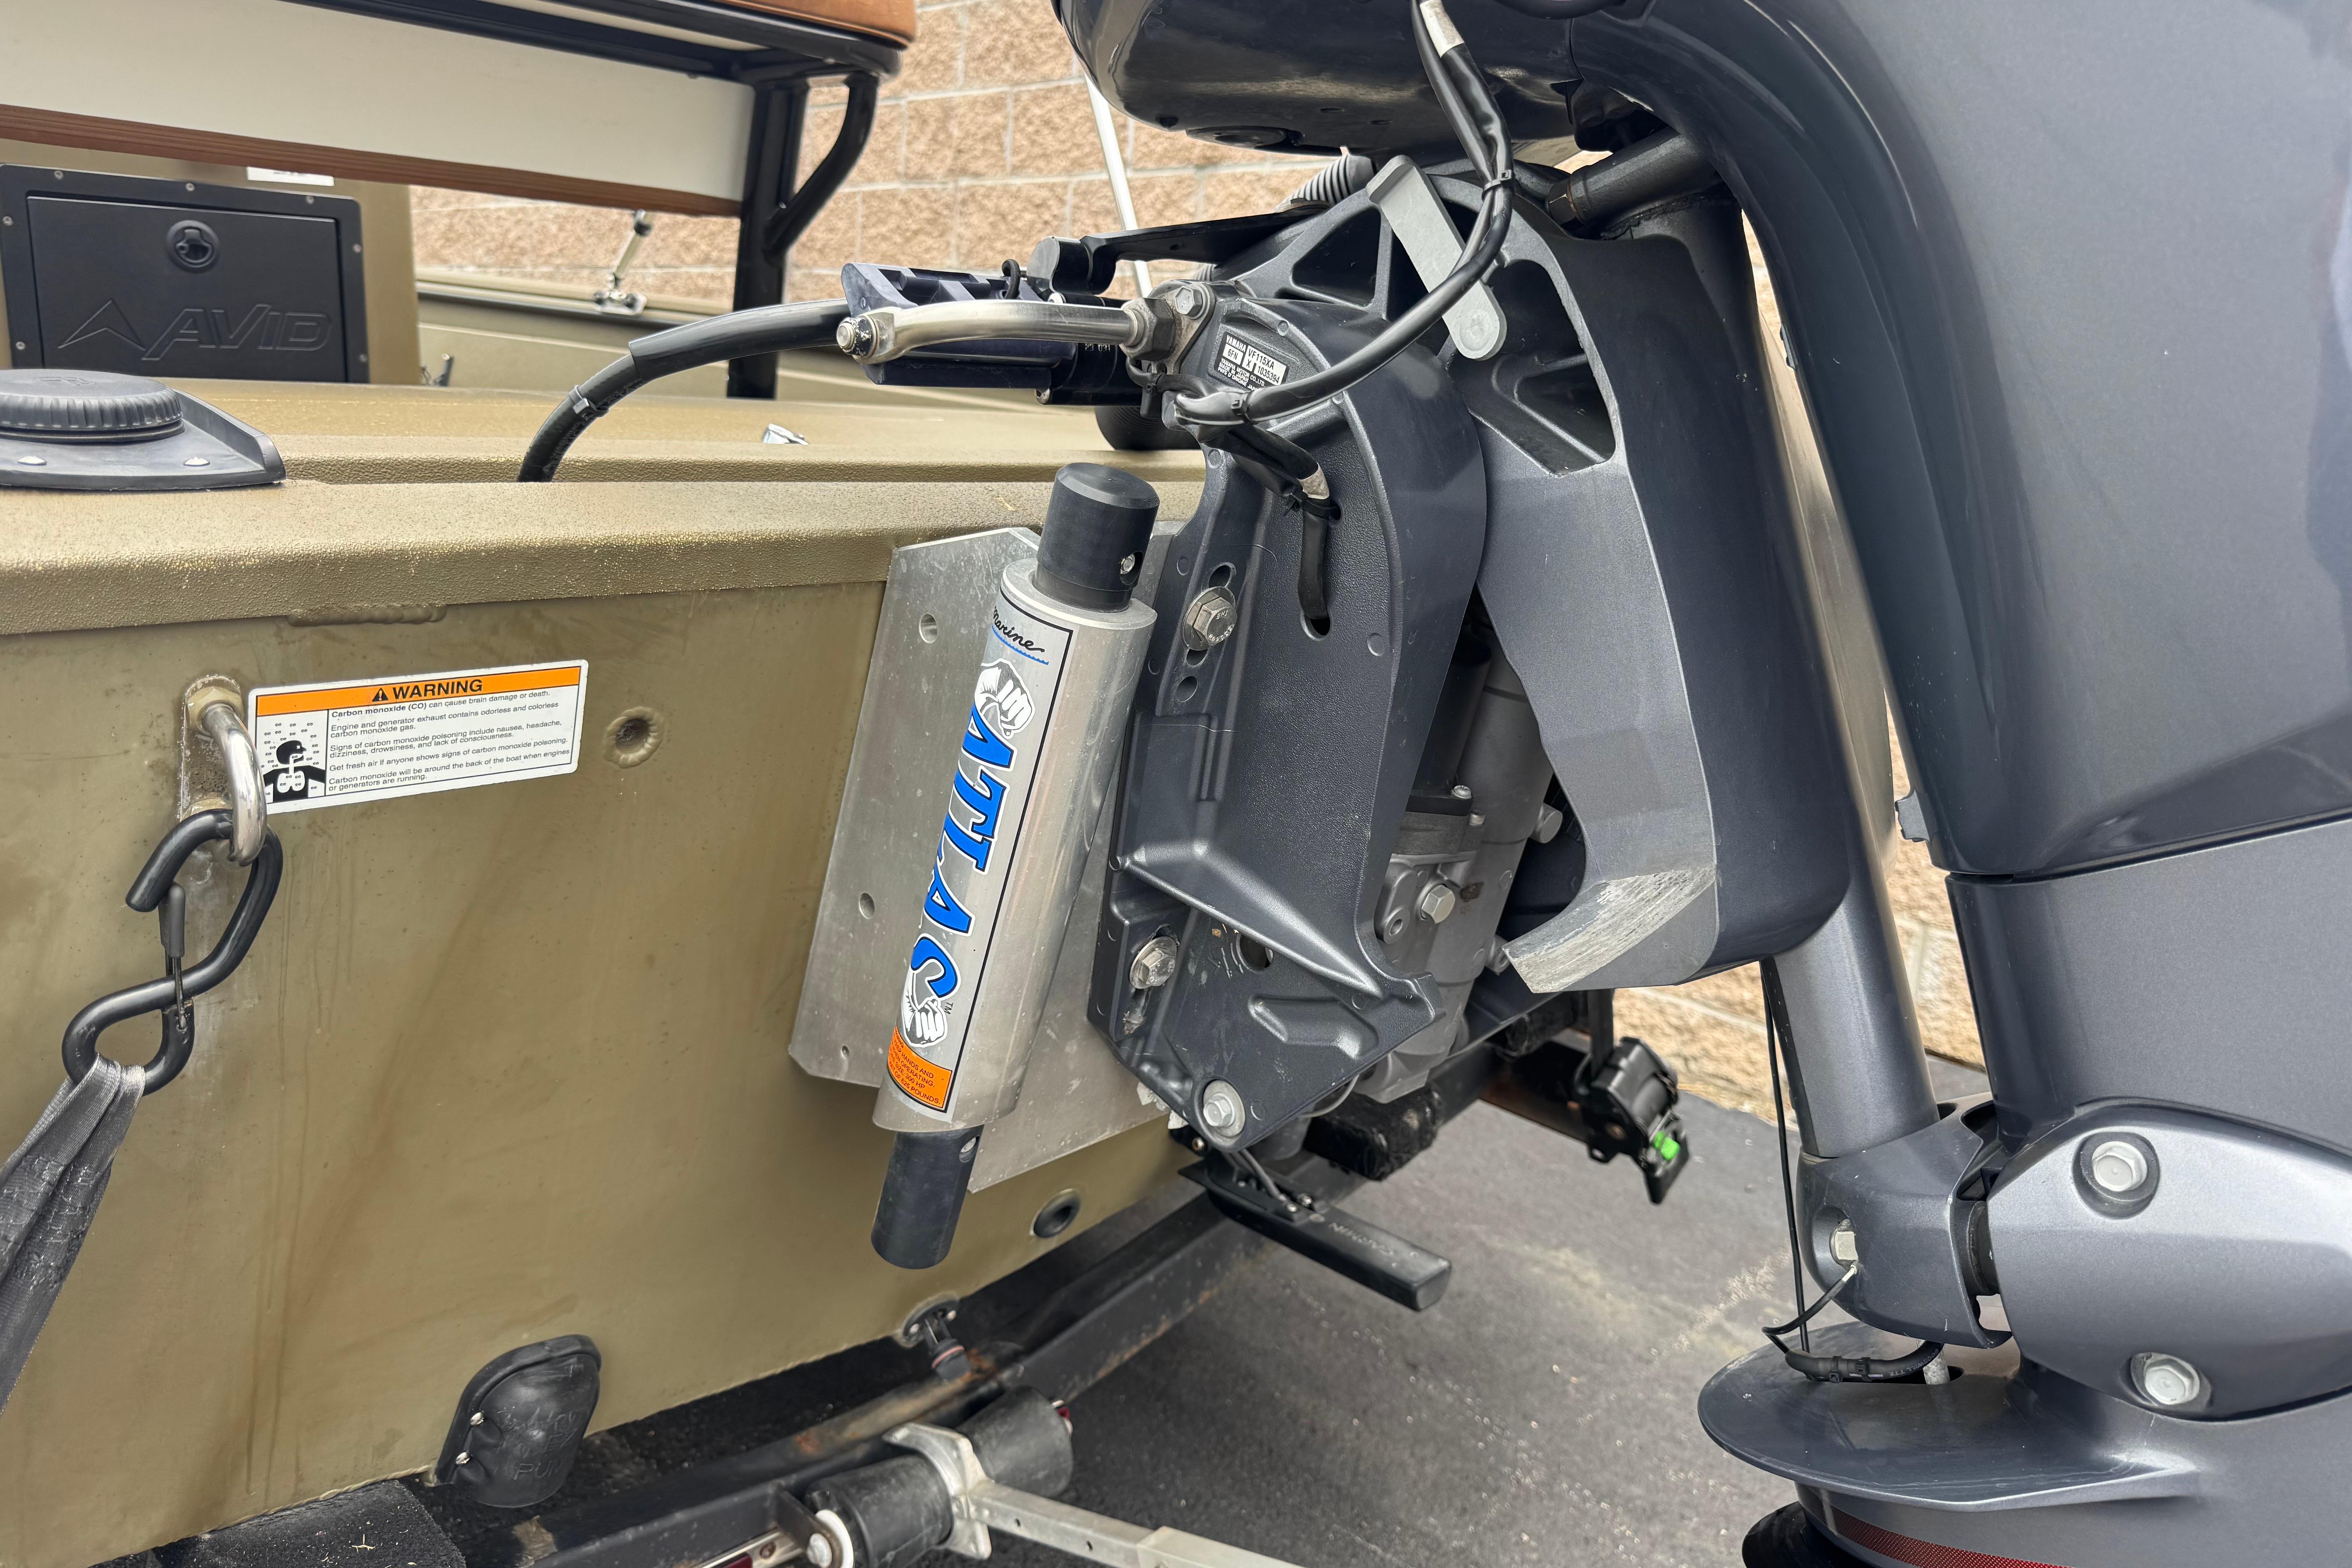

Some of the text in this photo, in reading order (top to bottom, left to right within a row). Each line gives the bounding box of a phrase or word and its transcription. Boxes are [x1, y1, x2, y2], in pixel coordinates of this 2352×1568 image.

[141, 303, 331, 361] AVID
[1226, 335, 1246, 353] YAMAHA
[1227, 349, 1238, 360] 6FN
[1246, 359, 1251, 368] X
[1248, 348, 1274, 370] VF115XA
[1218, 366, 1227, 376] PAYS
[1219, 362, 1230, 372] MADE
[1236, 372, 1249, 382] JAPAN
[1221, 357, 1235, 370] YAMAHA
[1237, 367, 1250, 378] MOTOR
[1258, 366, 1280, 384] 1035394
[392, 679, 483, 700] WARNING
[365, 705, 406, 714] monoxide
[408, 702, 427, 711] (CO)
[330, 725, 357, 738] carbon
[360, 726, 397, 735] monoxide
[331, 723, 359, 732] Engine
[378, 717, 415, 728] generator
[418, 713, 446, 722] exhaust
[329, 749, 368, 758] dizziness,
[371, 744, 415, 753] drowsiness,
[459, 732, 513, 743] consciousness.
[330, 744, 352, 753] Signs
[393, 735, 430, 744] monoxide
[432, 731, 467, 742] poisoning
[526, 720, 562, 729] headache,
[386, 757, 414, 765] anyone
[498, 742, 532, 751] monoxide
[533, 737, 567, 747] poisoning.
[360, 771, 397, 780] monoxide
[424, 763, 450, 772] around
[543, 749, 569, 757] engines
[338, 780, 380, 791] generators
[397, 774, 427, 782] running.
[910, 697, 1015, 1000] ATLAS
[944, 1001, 954, 1015] TM
[901, 1060, 935, 1087] OPERATING.
[902, 1052, 919, 1070] HANDS
[919, 1068, 934, 1078] AND
[911, 1086, 941, 1104] POUNDS.
